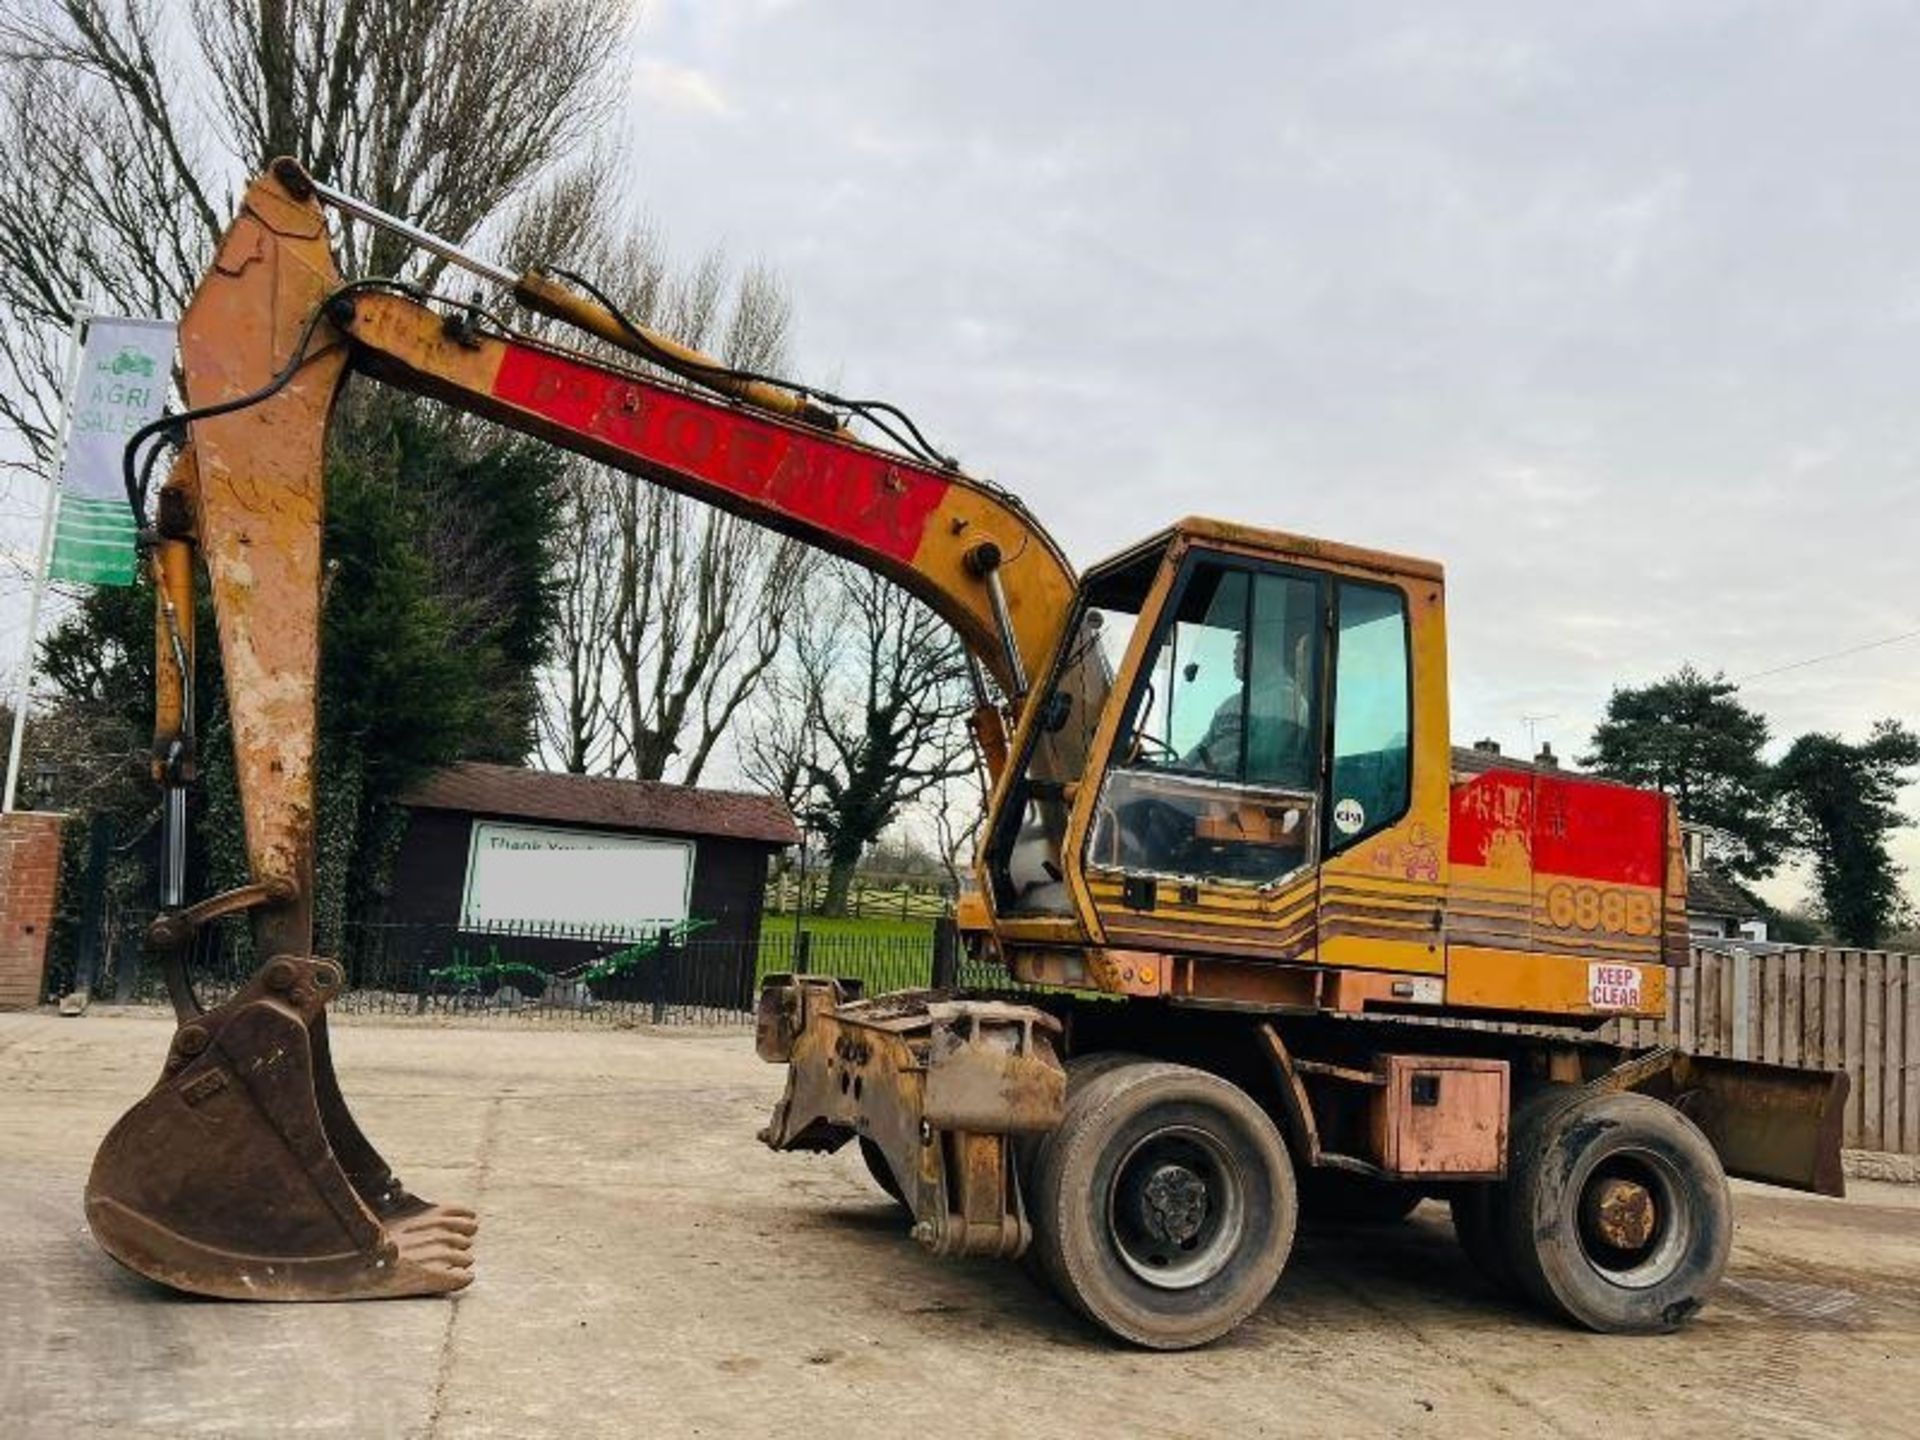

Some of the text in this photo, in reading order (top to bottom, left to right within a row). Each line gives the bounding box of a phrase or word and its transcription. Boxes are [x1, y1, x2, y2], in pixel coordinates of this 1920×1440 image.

[91, 383, 152, 408] AGRI
[1546, 883, 1655, 935] 688B
[1598, 966, 1633, 987] KEEP
[1592, 986, 1638, 1006] CLEAR
